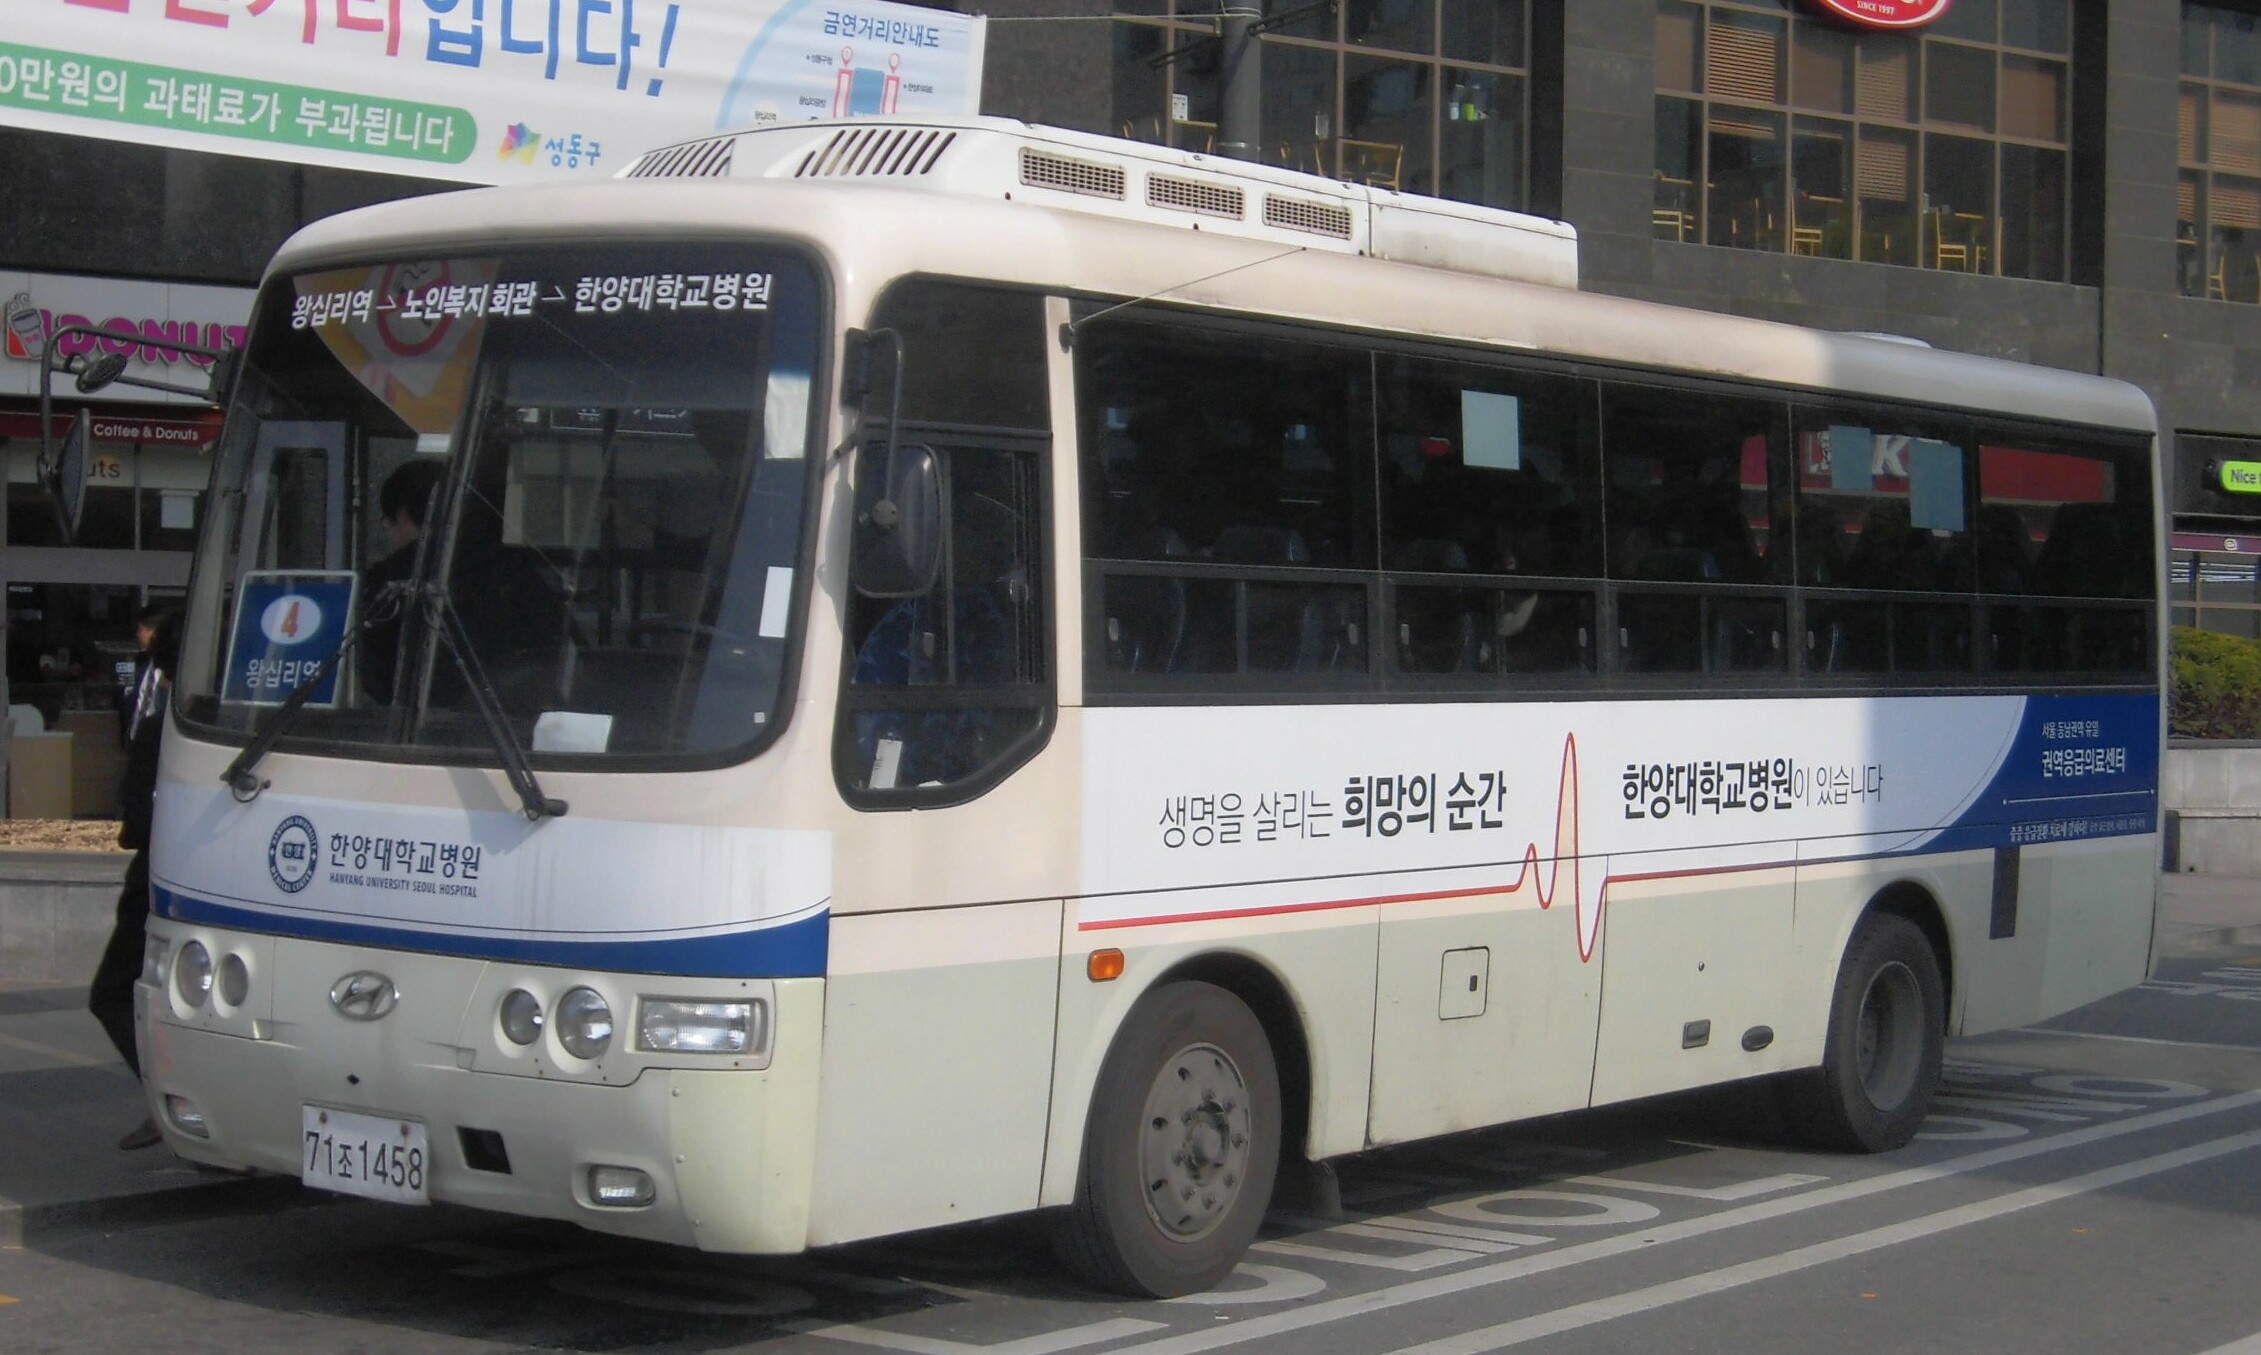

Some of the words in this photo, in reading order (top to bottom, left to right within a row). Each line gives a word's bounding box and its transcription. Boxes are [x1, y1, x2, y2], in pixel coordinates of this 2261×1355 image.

[1856, 0, 1877, 12] SINCE
[1878, 4, 1895, 15] 1997
[824, 10, 940, 48] 금연거리안내도
[143, 76, 282, 133] 과태료가
[295, 96, 454, 155] 부과됩니다
[544, 132, 601, 169] 성동구
[291, 289, 373, 330] 왕십리역
[400, 280, 538, 320] 노인복지회관
[574, 272, 774, 315] 한양대학교병원
[92, 422, 140, 439] Coffee
[142, 426, 152, 439] &
[155, 426, 200, 441] Donuts
[2230, 468, 2257, 485] Nice
[280, 601, 300, 638] 4
[2041, 746, 2126, 777] 권역응급의료센터
[1815, 763, 1884, 807] 있습니다
[1158, 792, 1245, 849] 생명을
[1252, 789, 1334, 842] 살리는
[1341, 773, 1437, 838] 희망의
[1445, 769, 1507, 832] 순간
[330, 832, 482, 880] 한양대학교병원
[329, 872, 364, 887] HANYANG
[366, 876, 411, 892] UNIVERSITY
[412, 881, 436, 894] SEOUL
[439, 884, 478, 899] HOSPITAL
[305, 1130, 423, 1191] 71조1458
